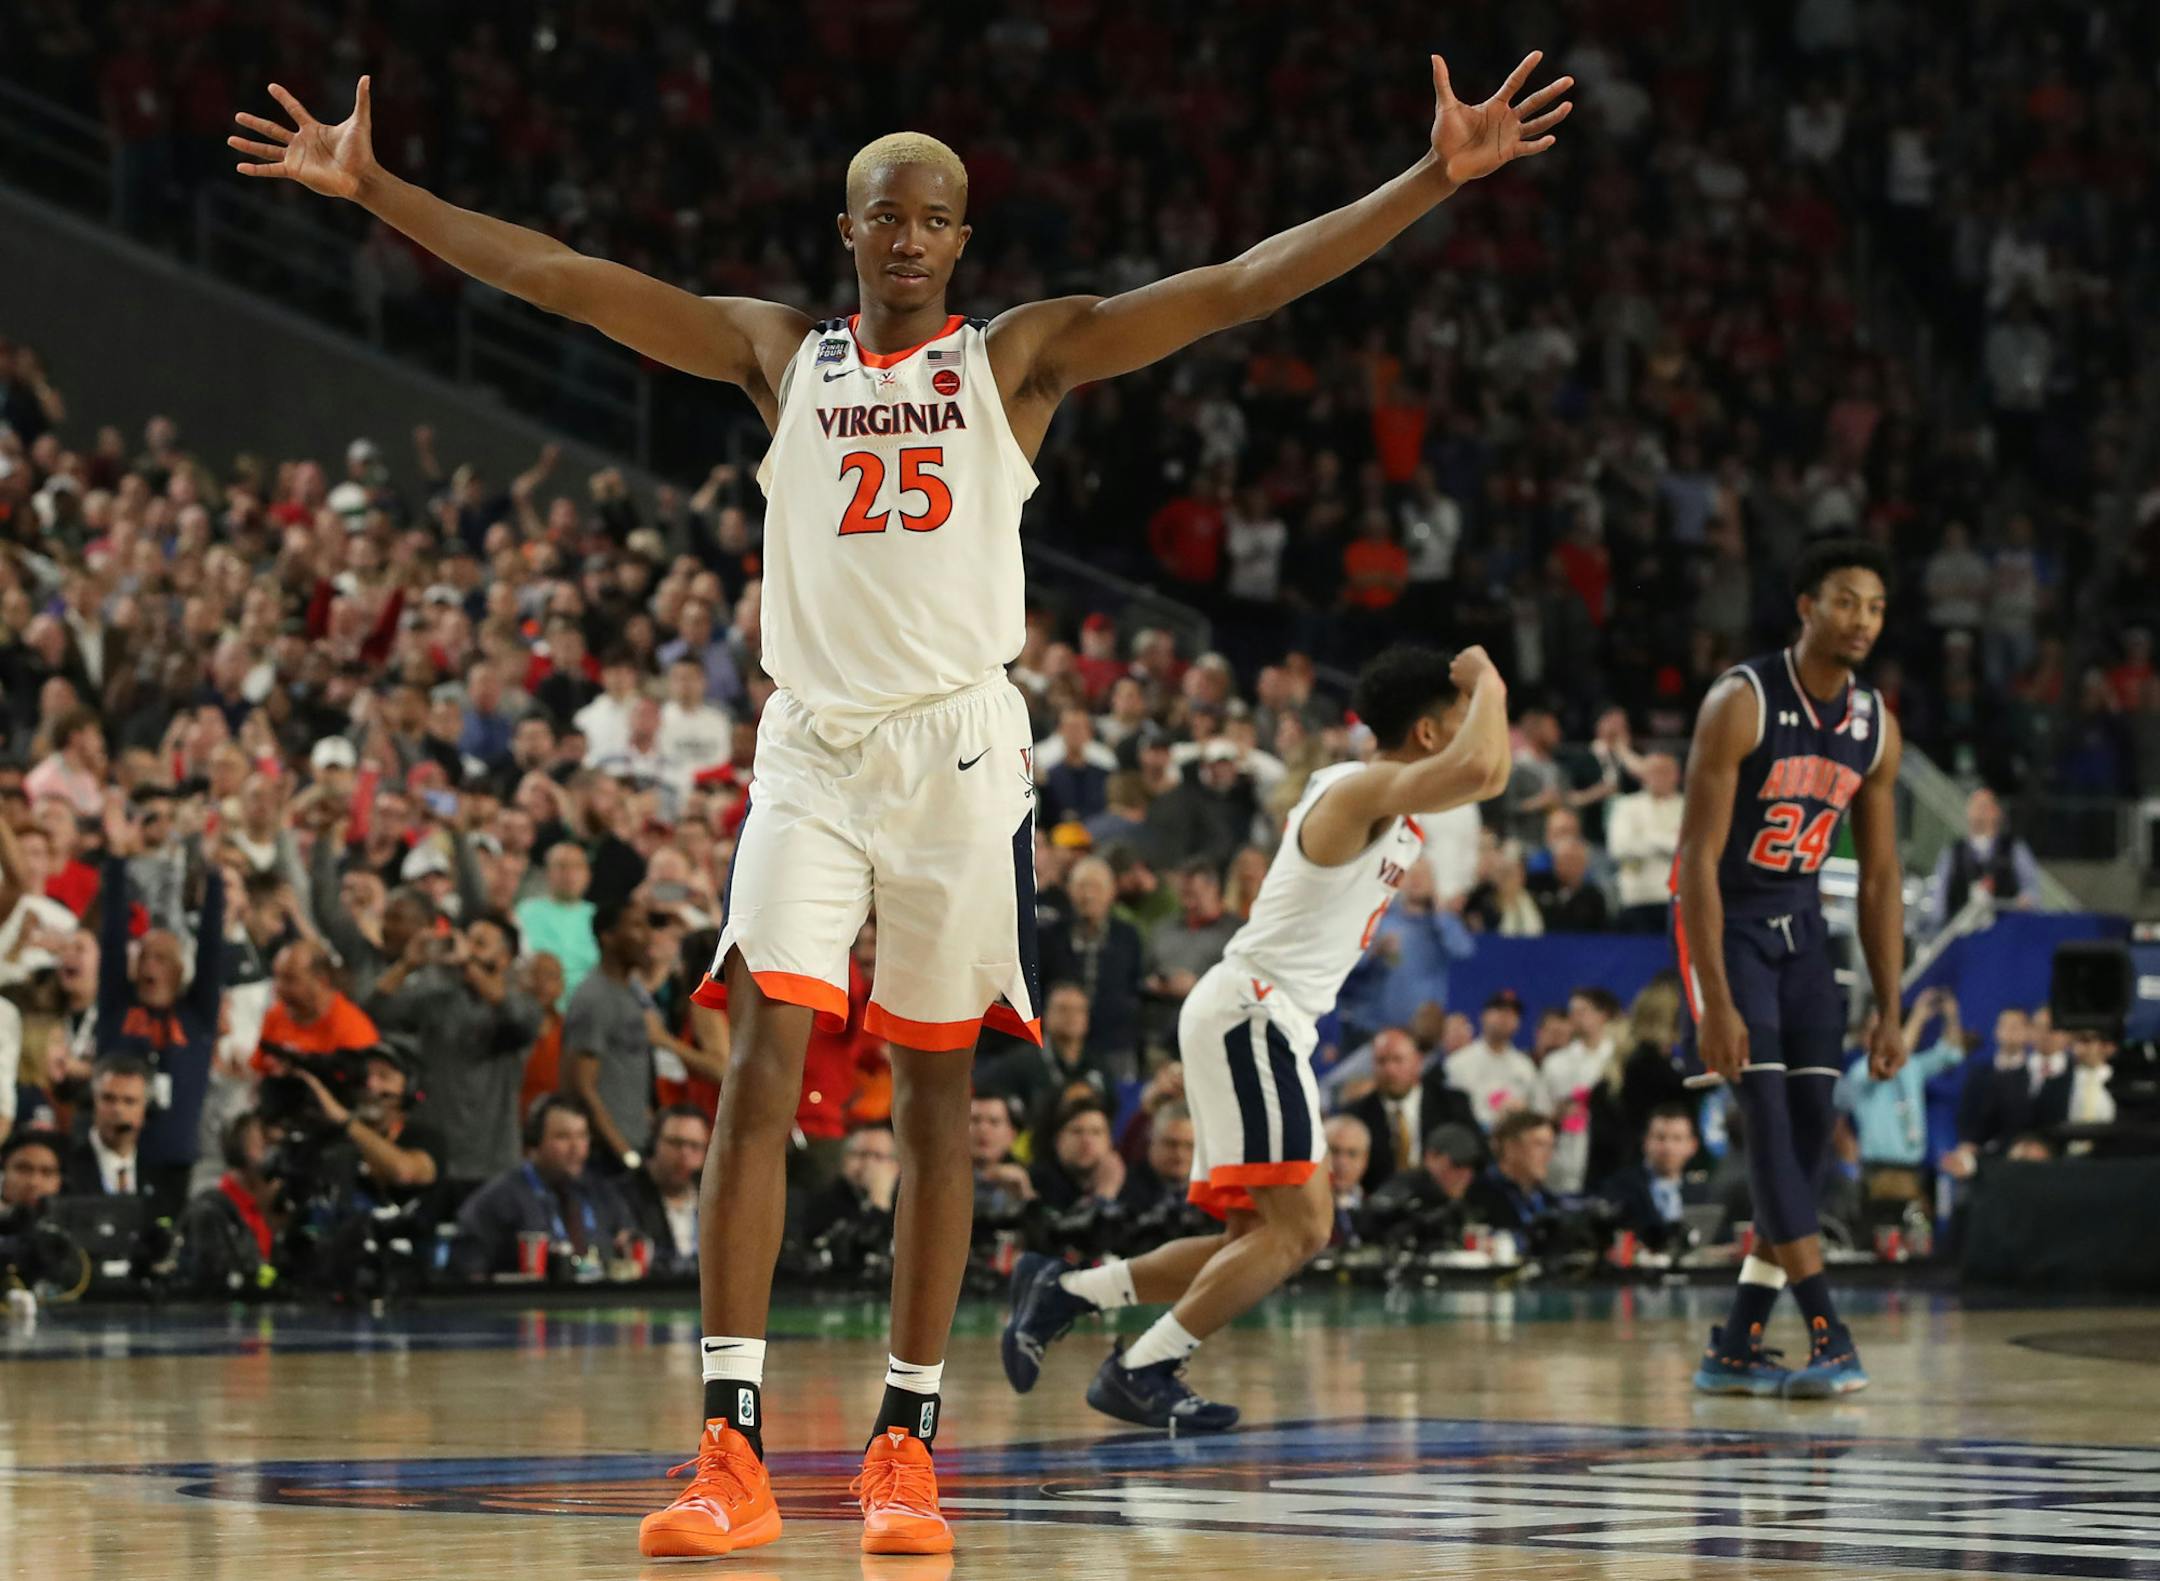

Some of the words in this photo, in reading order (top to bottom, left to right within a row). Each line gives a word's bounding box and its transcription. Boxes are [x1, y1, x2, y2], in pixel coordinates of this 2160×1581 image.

[816, 402, 967, 440] VIRGINIA
[838, 446, 953, 536] 25
[1747, 801, 1840, 873] 24
